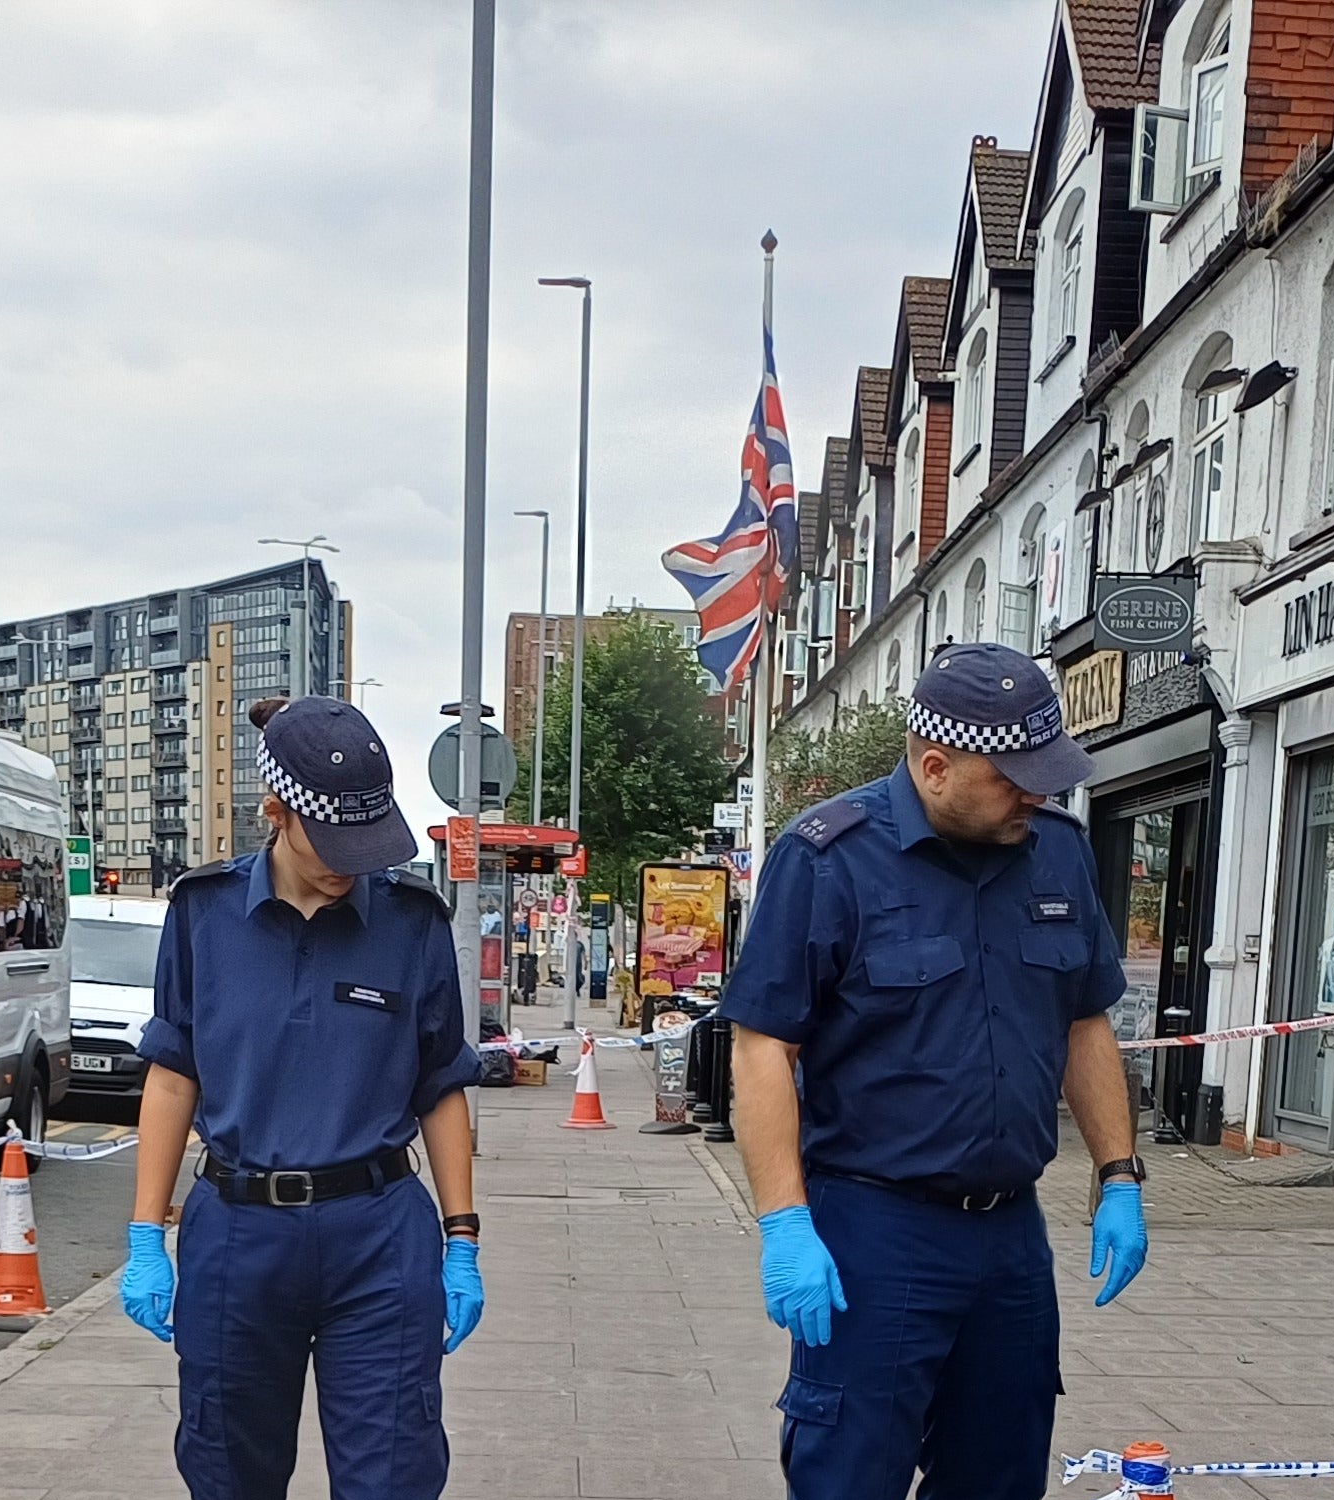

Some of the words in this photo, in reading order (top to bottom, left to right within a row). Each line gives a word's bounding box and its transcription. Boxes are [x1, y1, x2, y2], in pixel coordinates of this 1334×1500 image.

[1108, 601, 1181, 618] SERENE
[1110, 620, 1133, 629] FISH
[1136, 619, 1145, 629] &
[1147, 620, 1179, 630] CHIPS
[342, 812, 367, 821] POLICE
